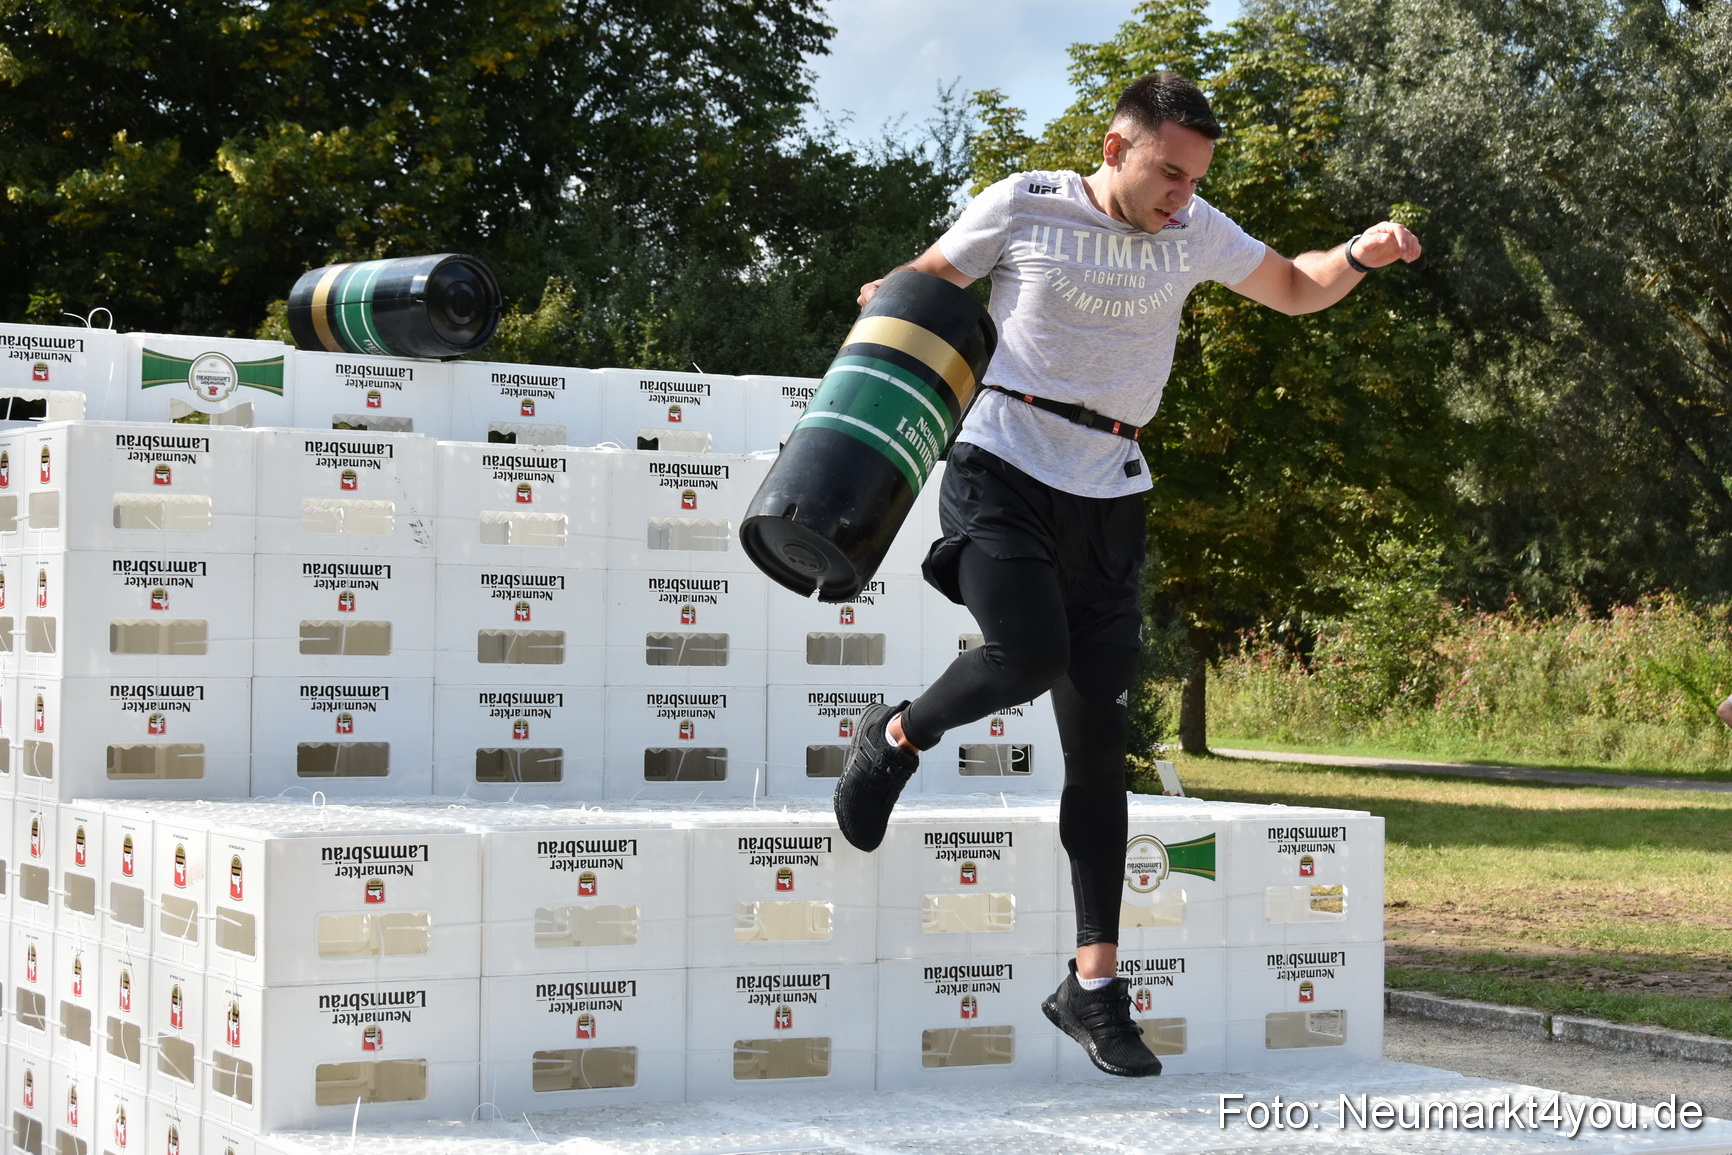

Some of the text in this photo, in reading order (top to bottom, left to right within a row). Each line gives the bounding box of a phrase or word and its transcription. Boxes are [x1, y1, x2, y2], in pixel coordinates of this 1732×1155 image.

[1029, 183, 1062, 194] UFC
[1030, 225, 1191, 273] ULTIMATE
[1083, 269, 1146, 288] FIGHTING
[1044, 266, 1175, 318] CHAMPIONSHIP
[0, 335, 83, 352] Lammsbräu
[9, 351, 71, 362] Neumarkter
[335, 363, 414, 381] Lammsbräu
[346, 379, 401, 390] Neumarkter
[492, 373, 565, 390] Lammsbräu
[641, 381, 710, 396] Lammsbräu
[501, 388, 554, 399] Neumarkter
[649, 395, 700, 405] Neumarkter
[782, 386, 817, 400] sbräu
[117, 435, 209, 452] Lammsbräu
[305, 441, 393, 458] Lammsbräu
[128, 452, 196, 464] Neumarkter
[316, 458, 380, 469] Neumarkter
[483, 455, 566, 472] Lammsbräu
[493, 472, 554, 483] Neumarkter
[650, 463, 729, 479] Lammsbräu
[660, 479, 717, 489] Neumarkter
[113, 560, 206, 576] Lammsbräu
[303, 563, 391, 579] Lammsbräu
[125, 577, 193, 588] Neumarkter
[314, 580, 378, 591] Neumarkter
[481, 574, 564, 589] Lammsbräu
[649, 579, 728, 593] Lammsbräu
[491, 590, 552, 601] Neumarkter
[659, 594, 717, 605] Neumarkter
[111, 686, 203, 700] Lammsbräu
[301, 686, 389, 700] Lammsbräu
[480, 693, 563, 707] Lammsbräu
[808, 692, 884, 706] Lammsbräu
[122, 702, 190, 713] Neumarkter
[311, 702, 376, 713] Neumarkter
[647, 694, 726, 708] Lammsbräu
[490, 709, 551, 719] Neumarkter
[657, 710, 715, 720] Neumarkter
[818, 707, 865, 717] umarkter
[925, 832, 1012, 848] Lammsbräu
[1268, 827, 1346, 842] Lammsbräu
[538, 840, 637, 858] Lammsbräu
[739, 837, 831, 853] Lammsbräu
[1278, 844, 1335, 855] Neumarkter
[322, 845, 428, 864] Lammsbräu
[750, 855, 818, 867] Neumarkter
[936, 850, 1000, 862] Neumarkter
[335, 865, 413, 878] Neumarkter
[550, 859, 623, 872] Neumarkter
[1116, 958, 1185, 975] Lammsbr
[1268, 952, 1345, 969] Lammsbräu
[924, 964, 1012, 983] Lammsbräu
[1277, 969, 1334, 981] Neumarkter
[737, 974, 830, 992] Lammsbräu
[936, 982, 1000, 994] Neumarkter
[537, 981, 636, 1001] Lammsbräu
[319, 991, 425, 1012] Lammsbräu
[748, 993, 817, 1005] Neumarkter
[549, 1000, 622, 1014] Neumarkter
[333, 1011, 411, 1026] Neumarkter
